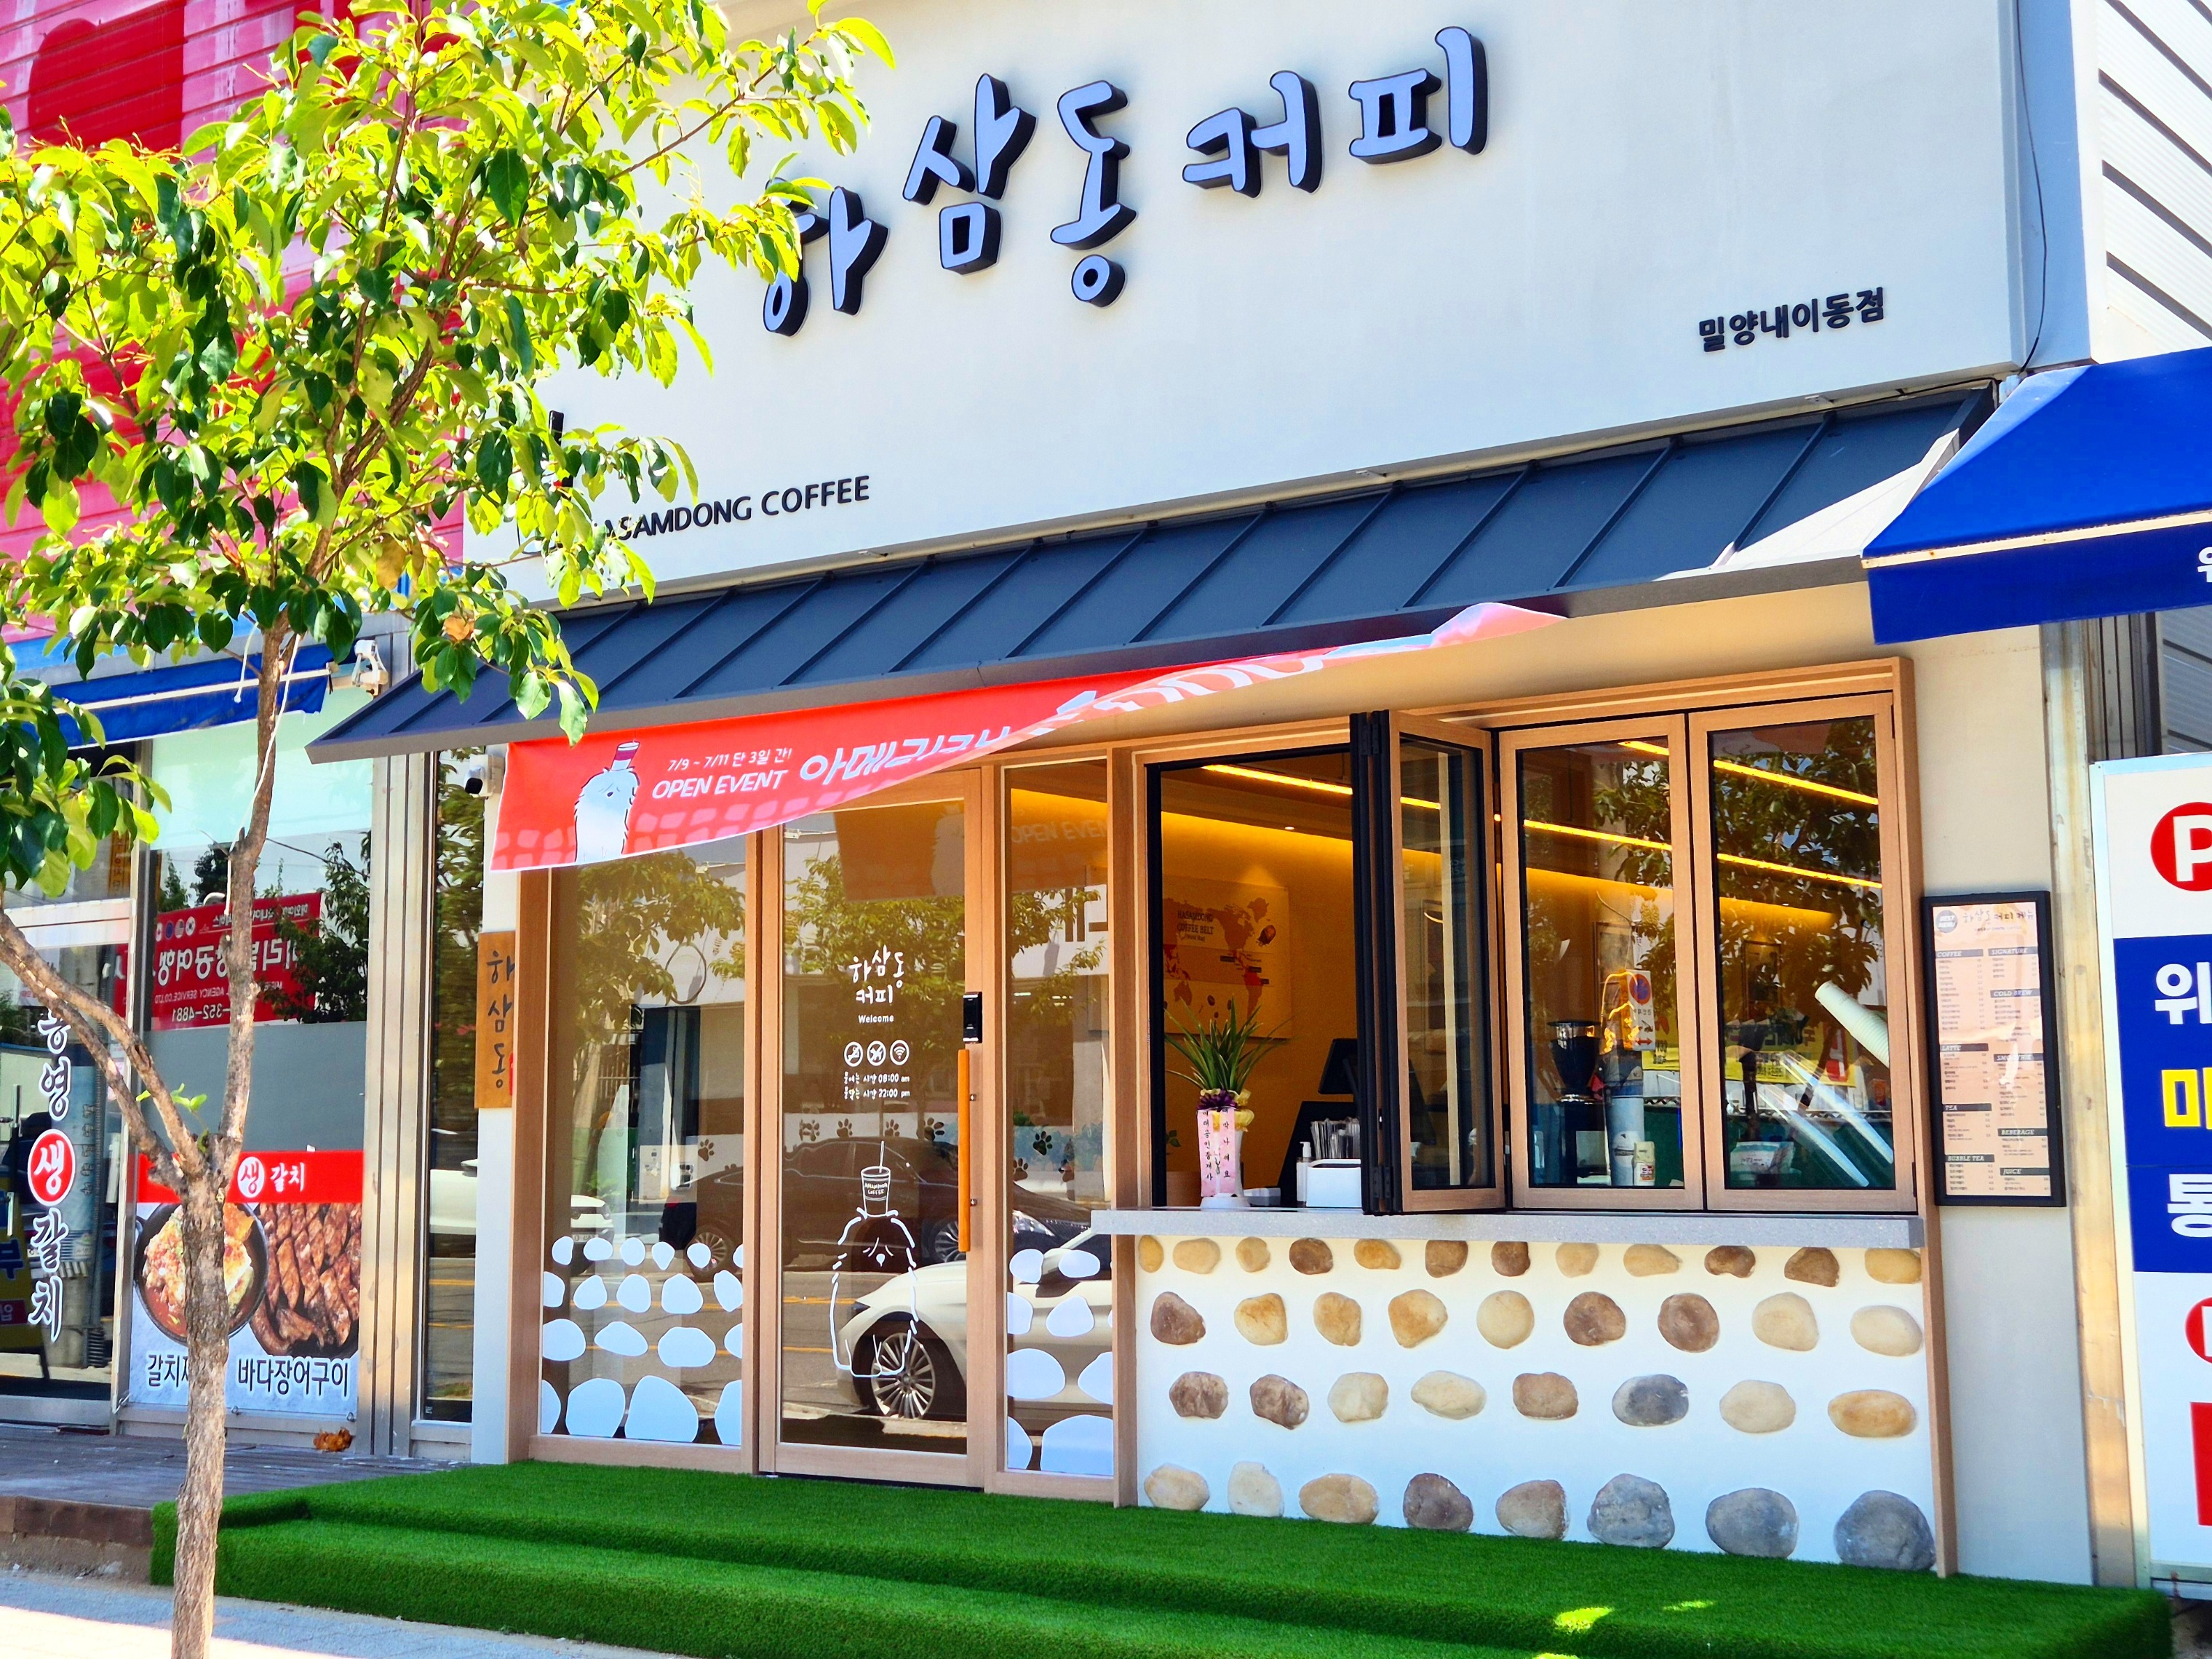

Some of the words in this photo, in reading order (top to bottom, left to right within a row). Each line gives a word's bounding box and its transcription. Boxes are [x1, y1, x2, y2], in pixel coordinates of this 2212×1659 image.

[764, 73, 1137, 338] 하삼동
[1182, 26, 1488, 199] 커피
[1699, 287, 1885, 352] 밀양내이동점
[594, 496, 752, 541] ASAMDONG
[761, 474, 871, 517] COFFEE
[667, 758, 690, 772] 7/9
[704, 753, 731, 770] 7/11
[732, 751, 747, 768] 단
[749, 749, 771, 765] 3일
[651, 775, 713, 800] OPEN
[714, 769, 789, 795] EVENT
[848, 944, 904, 988] 하삼동
[856, 984, 894, 1004] 커피
[487, 950, 515, 1089] 하삼동
[858, 1014, 894, 1023] Welcome
[878, 1073, 899, 1083] 08:00
[878, 1088, 899, 1098] 22:00
[901, 1090, 910, 1098] pm
[271, 1163, 305, 1192] 갈치
[148, 1354, 188, 1387] 갈치
[238, 1357, 349, 1398] 바다장어구이
